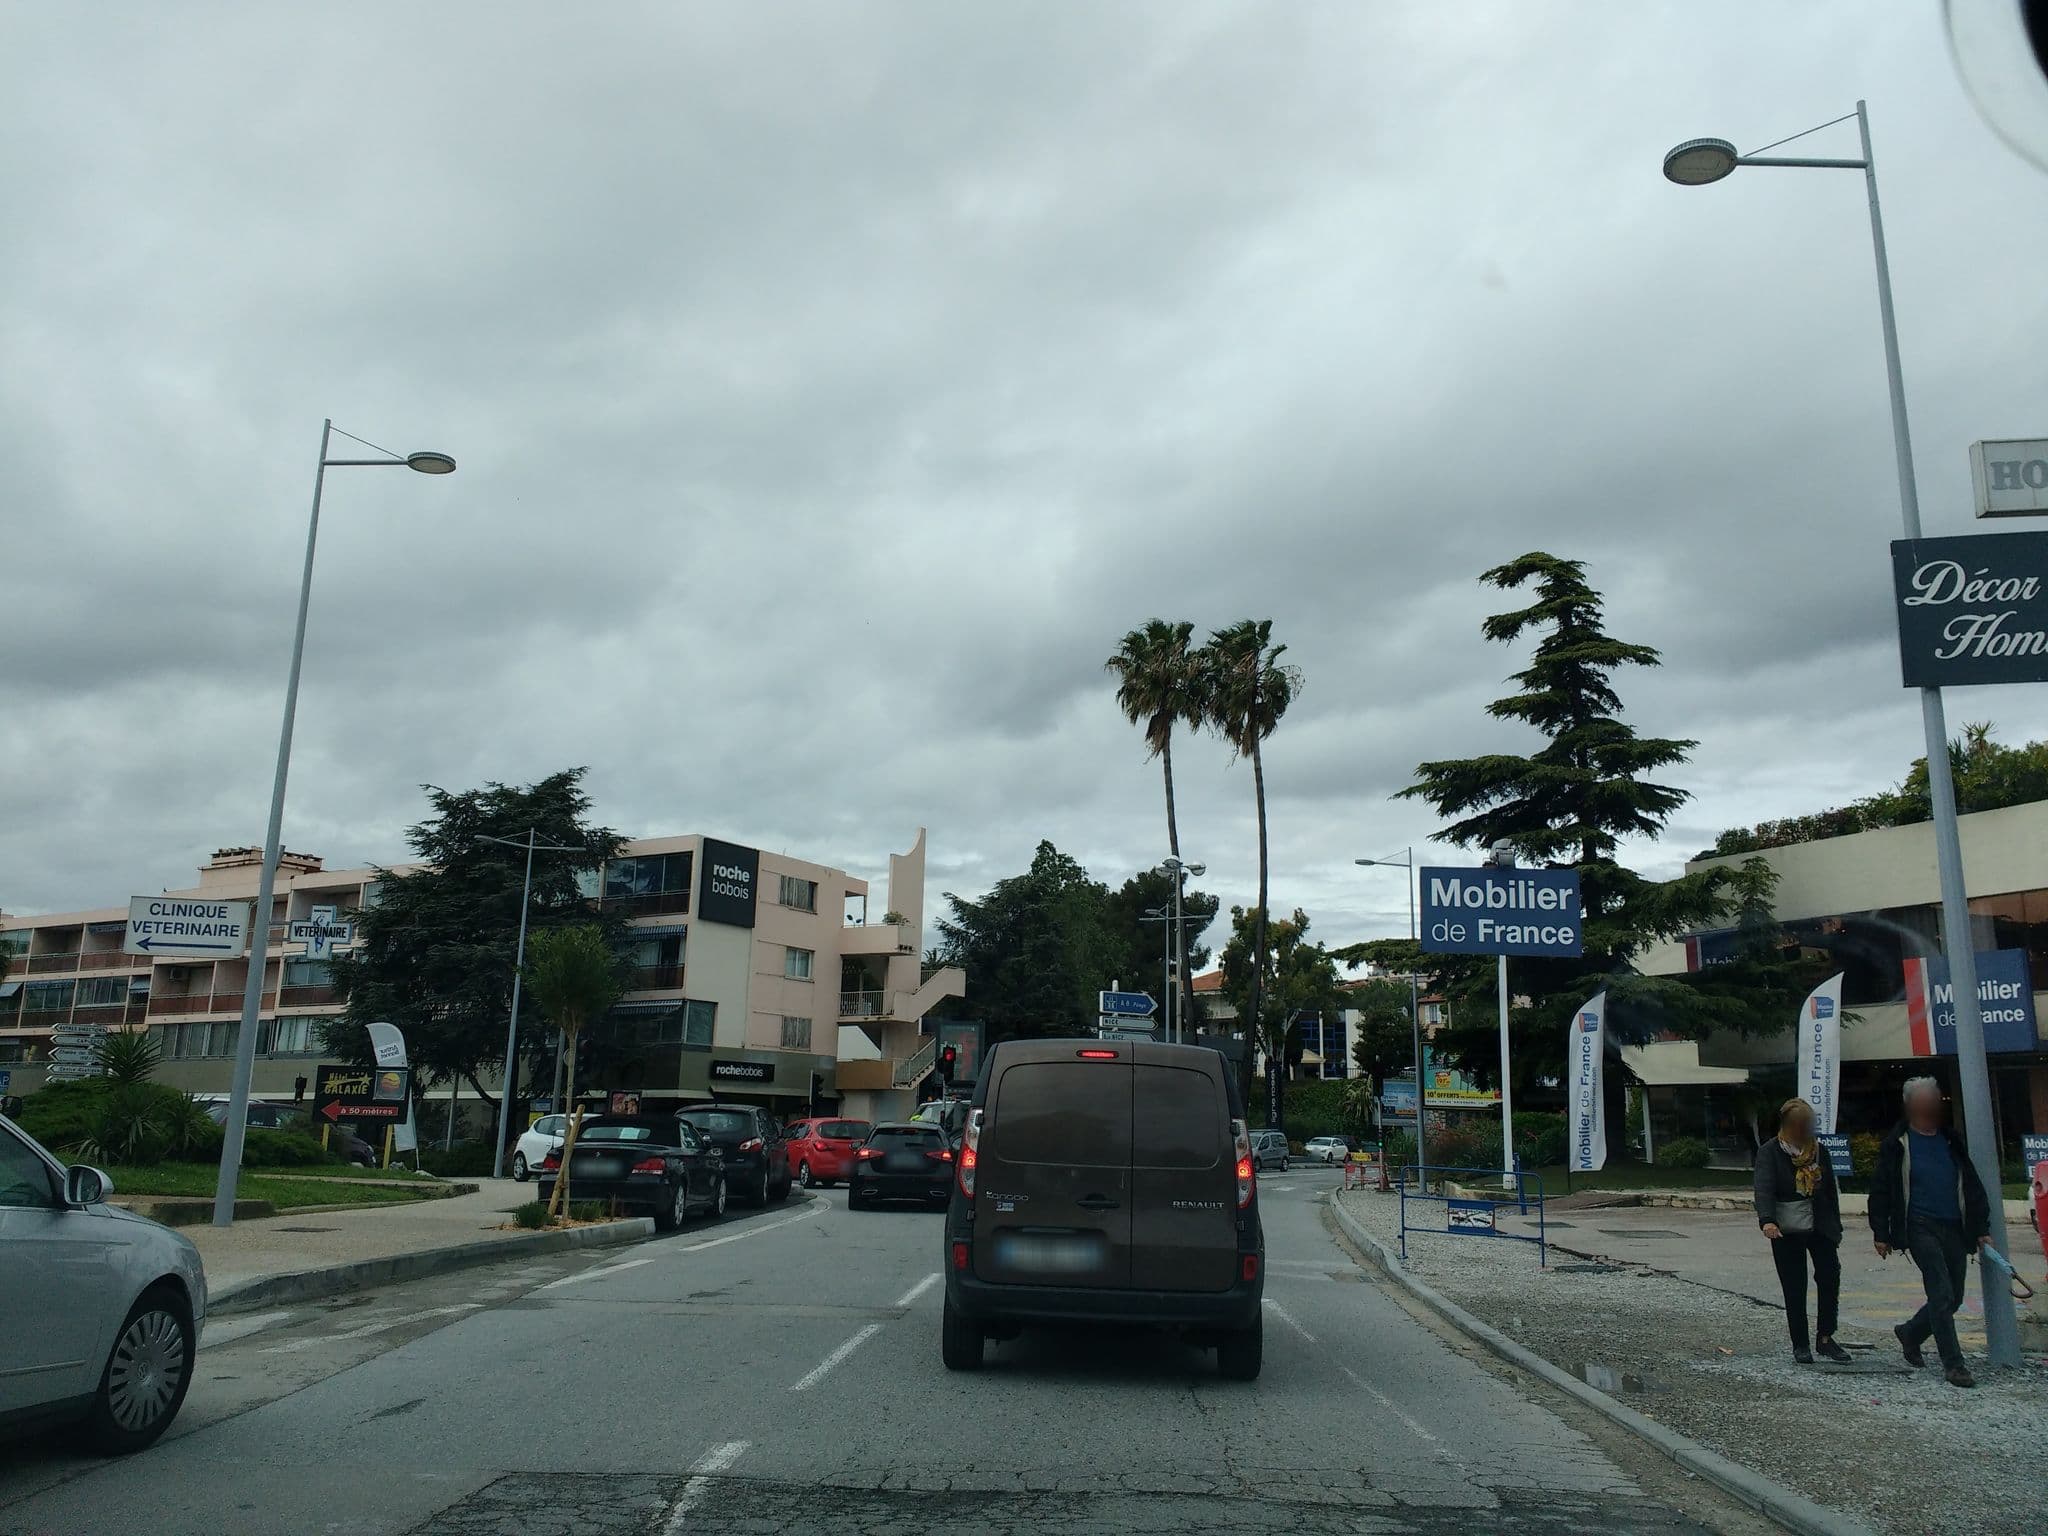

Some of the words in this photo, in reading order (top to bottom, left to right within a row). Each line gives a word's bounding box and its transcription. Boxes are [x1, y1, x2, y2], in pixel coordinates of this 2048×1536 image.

[1904, 560, 2041, 606] Décor
[1935, 611, 2048, 659] Hom
[713, 864, 750, 882] roche
[712, 878, 749, 899] bobois
[1431, 878, 1573, 910] Mobilier
[149, 903, 228, 919] CLINIQUE
[132, 920, 240, 937] VETERINAIRE
[294, 926, 347, 938] VETERINAIRE
[1432, 918, 1466, 942] de
[1478, 919, 1574, 945] France
[1934, 980, 2021, 1004] Milier
[1581, 1036, 1591, 1086] France
[1812, 1023, 1823, 1080] France
[716, 1065, 764, 1077] rochebobois
[324, 1085, 368, 1095] GALAXIE
[1581, 1091, 1590, 1108] de
[1811, 1090, 1822, 1105] de
[1579, 1112, 1592, 1169] Mobilier
[1173, 1201, 1225, 1210] RENAULT
